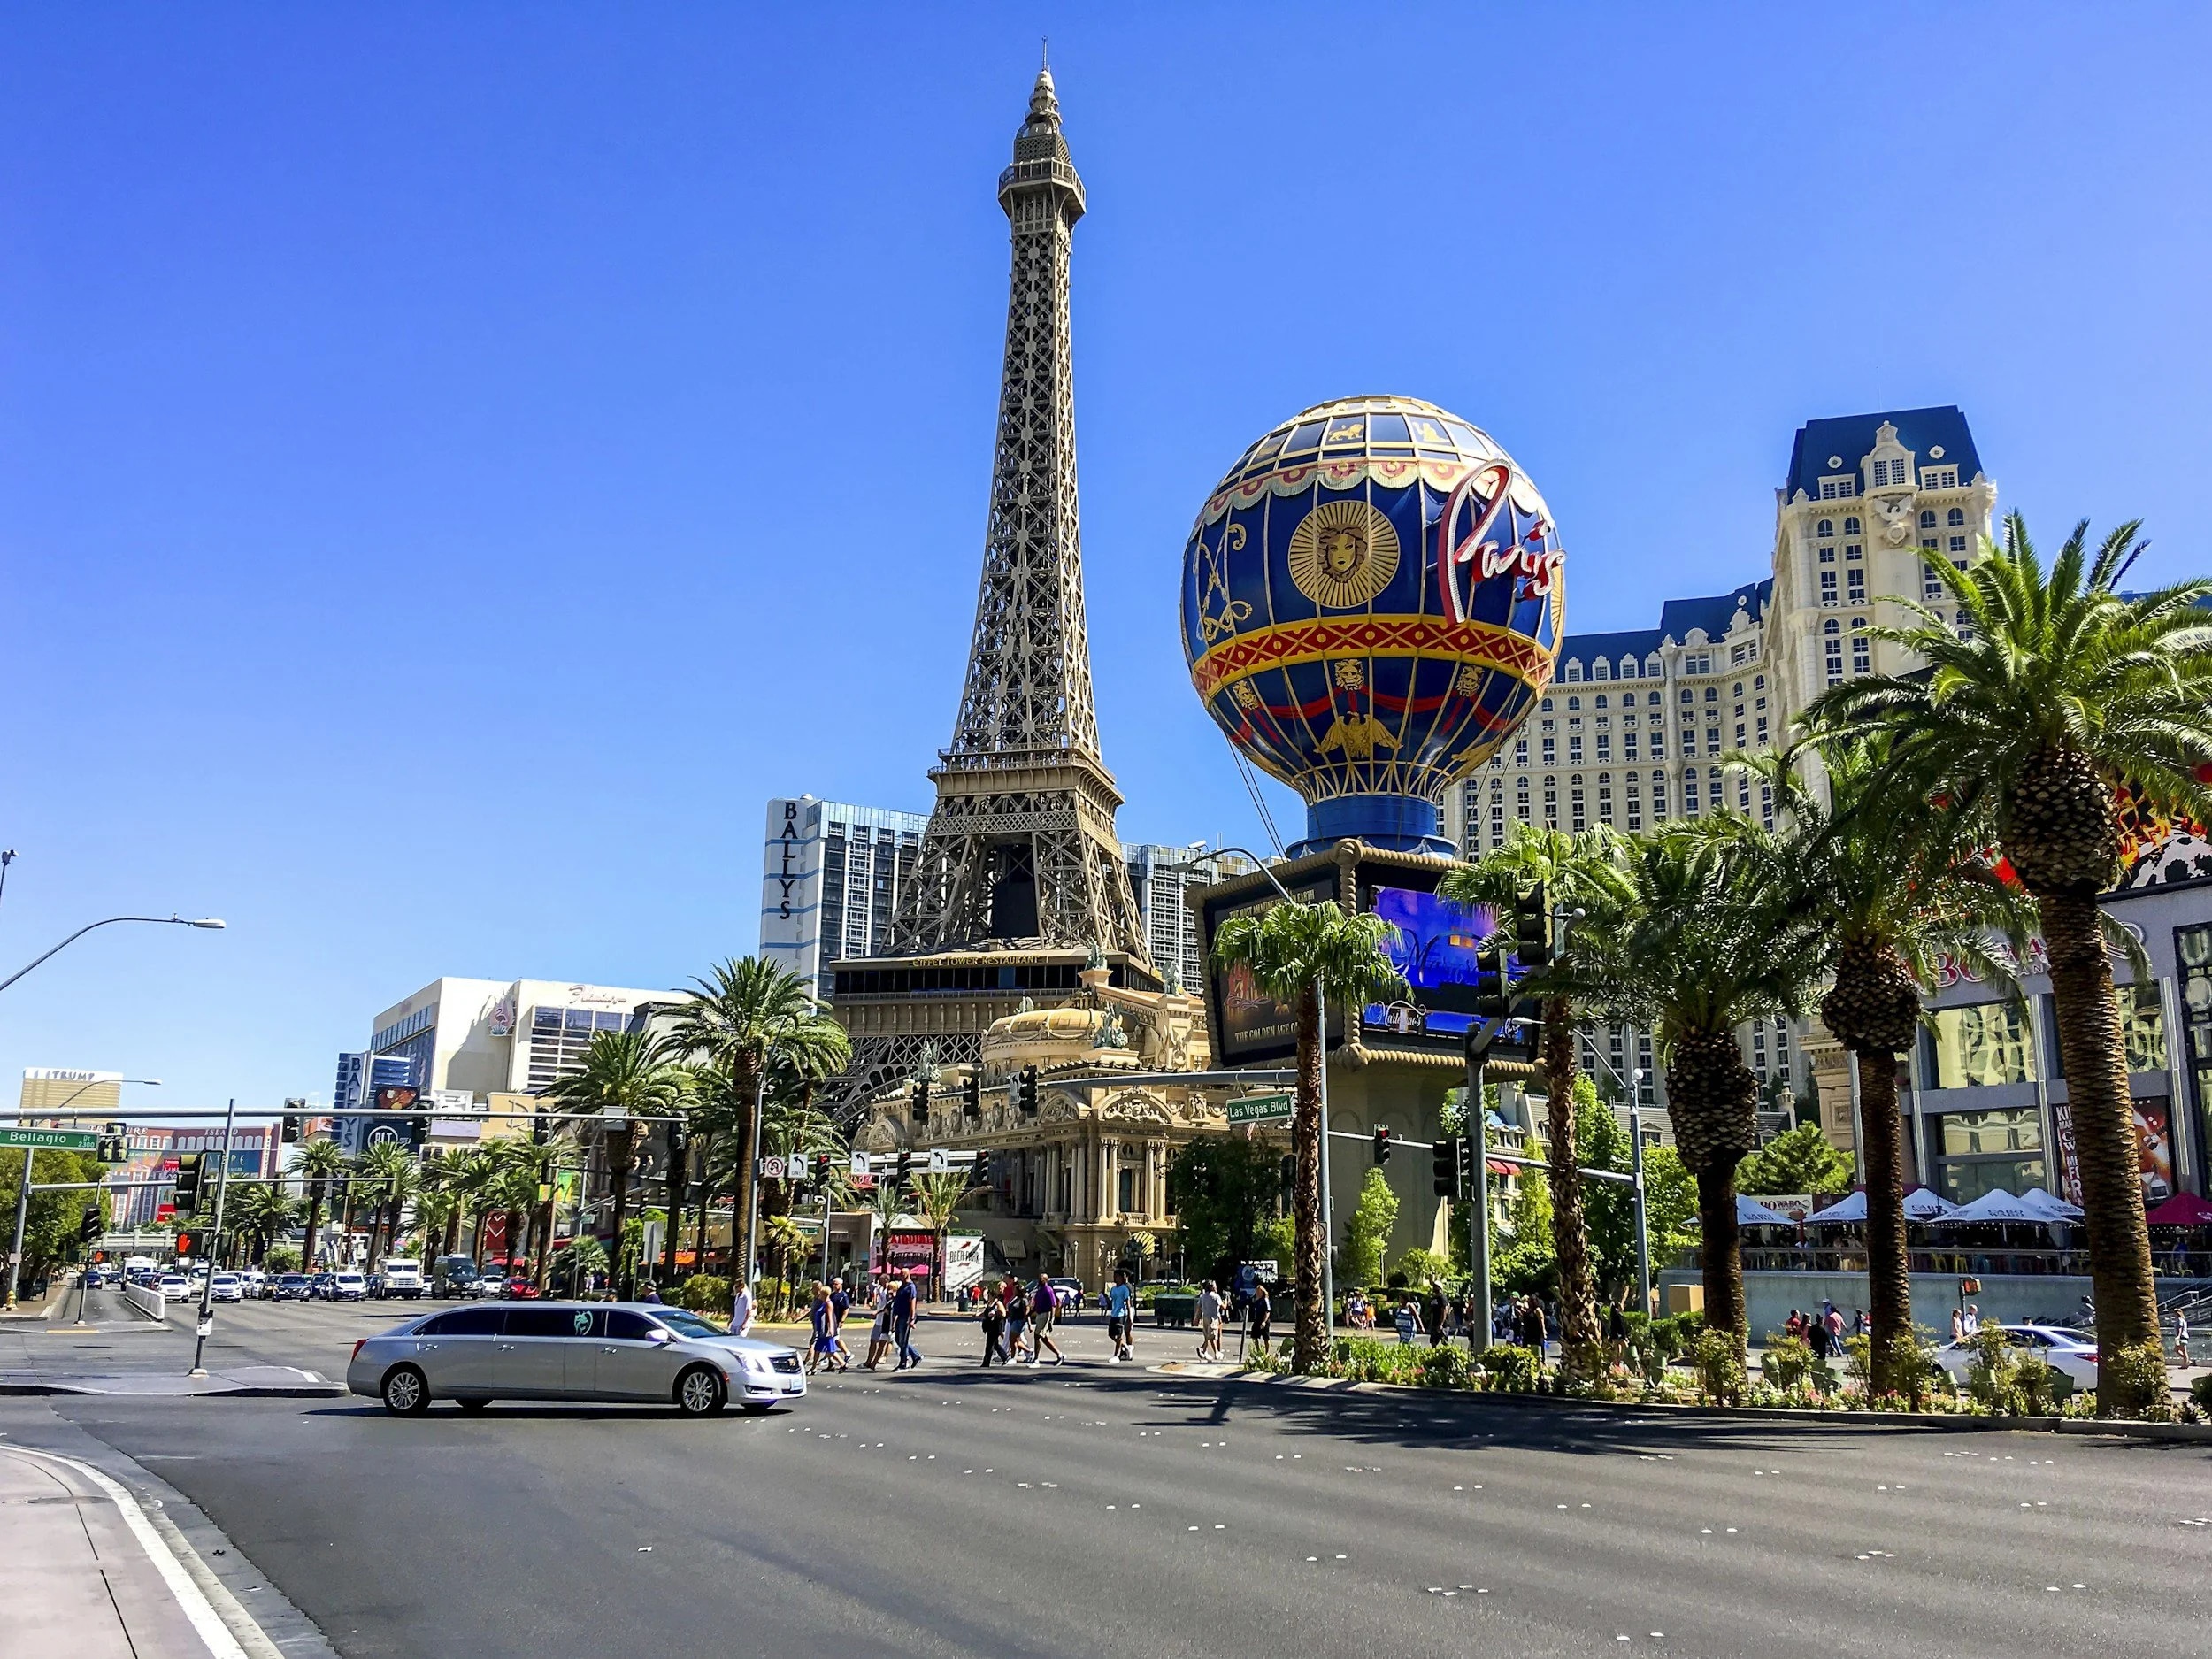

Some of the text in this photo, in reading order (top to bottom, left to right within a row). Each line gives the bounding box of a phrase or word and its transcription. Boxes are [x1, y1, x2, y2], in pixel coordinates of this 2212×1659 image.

[1439, 458, 1567, 626] Paris
[1297, 889, 1315, 902] EARTH
[946, 956, 978, 966] TOWER
[1235, 1030, 1248, 1042] THE
[1248, 1025, 1275, 1041] GOLDEN
[52, 1070, 96, 1080] TRUMP
[1229, 1100, 1289, 1118] Las Vegas Blvd
[89, 1125, 149, 1135] TRURE
[9, 1131, 67, 1145] Bellagio
[949, 1250, 964, 1263] BEER
